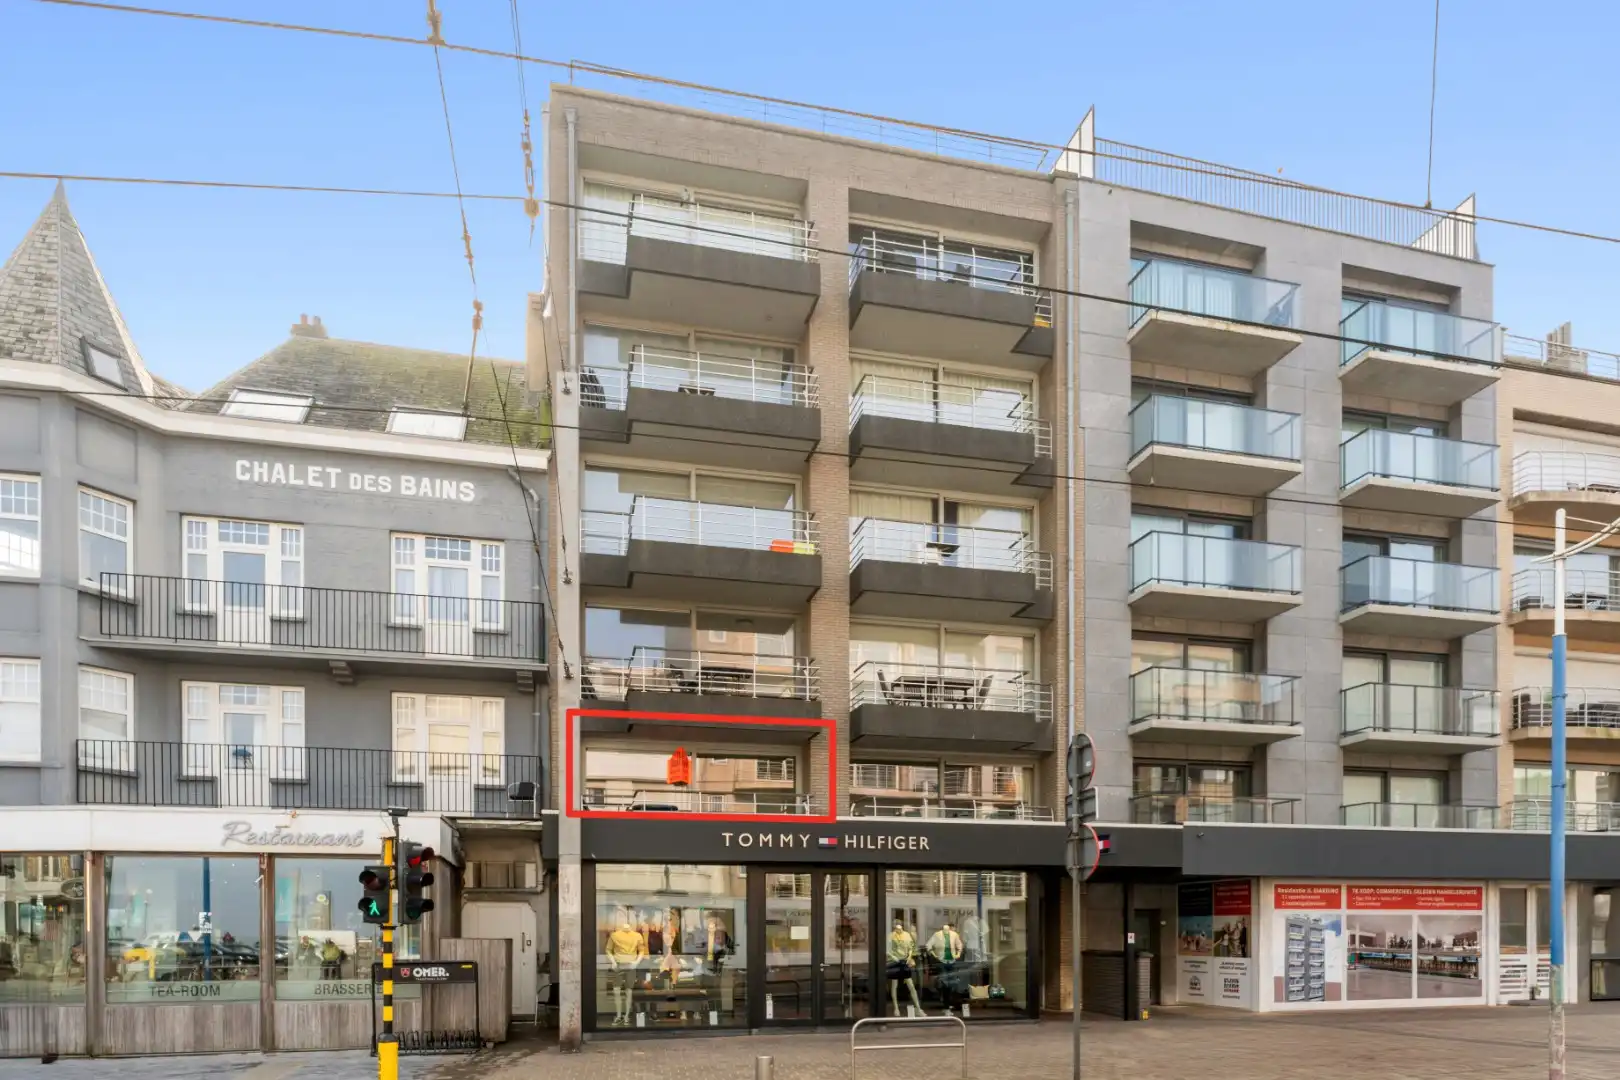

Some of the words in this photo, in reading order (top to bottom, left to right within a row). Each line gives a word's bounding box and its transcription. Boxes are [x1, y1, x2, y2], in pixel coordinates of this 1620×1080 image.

[236, 459, 341, 489] CHALET
[349, 472, 392, 493] DES
[400, 474, 476, 503] BAINS
[221, 819, 365, 848] Restaurant
[722, 832, 811, 848] TOMMY
[844, 835, 930, 851] HILFIGER
[148, 985, 221, 998] TEA-ROOM
[314, 983, 384, 996] BRASSERE
